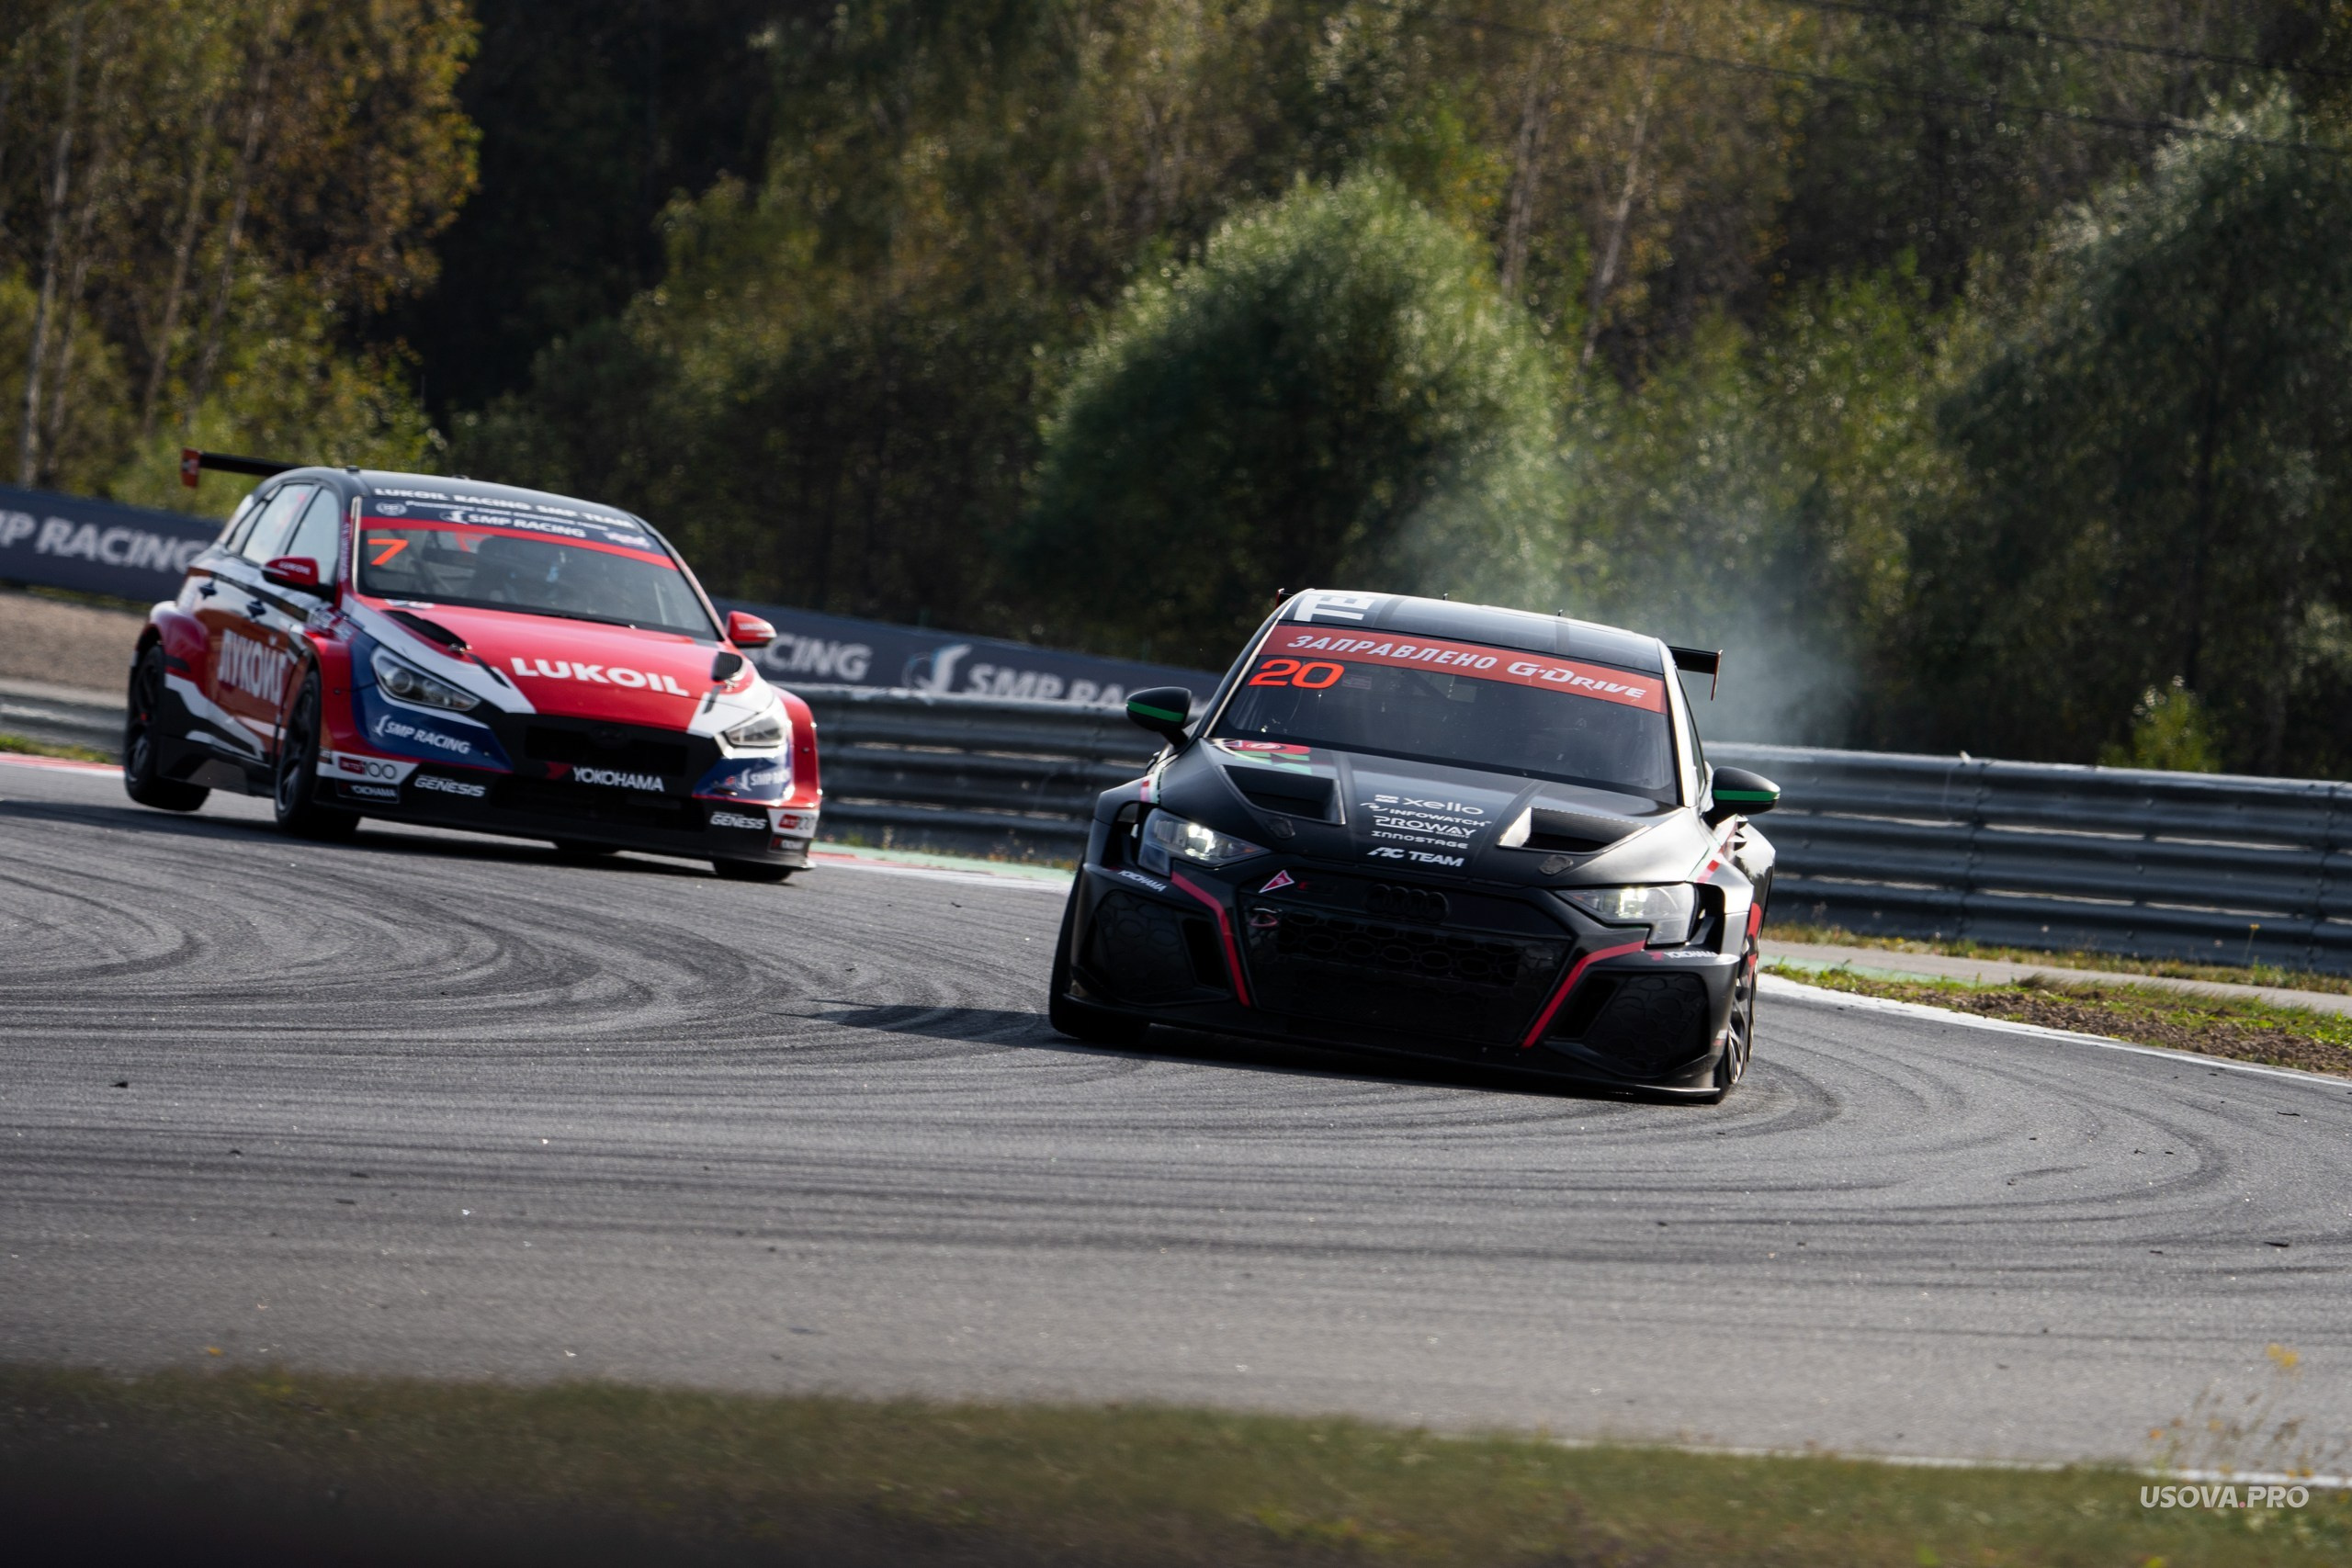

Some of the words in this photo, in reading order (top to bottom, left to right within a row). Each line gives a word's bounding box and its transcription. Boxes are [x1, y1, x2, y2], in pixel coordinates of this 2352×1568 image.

[468, 513, 511, 526] SMP
[514, 518, 587, 538] RACING
[368, 538, 408, 565] 7
[1286, 636, 1498, 671] ЗАПРАВЛЕНО
[510, 657, 689, 698] LUKOIL
[968, 663, 1064, 699] SMP
[1248, 659, 1344, 690] 20
[385, 720, 414, 739] SMP
[413, 728, 471, 754] RACING
[413, 777, 487, 797] GENESIS
[573, 766, 665, 793] YOKOHAMA
[1402, 797, 1485, 816] xello
[709, 814, 768, 829] GENESIS
[1373, 815, 1477, 837] PROWAY
[1408, 851, 1464, 867] TEAM
[1117, 870, 1167, 893] YOKOHAMA
